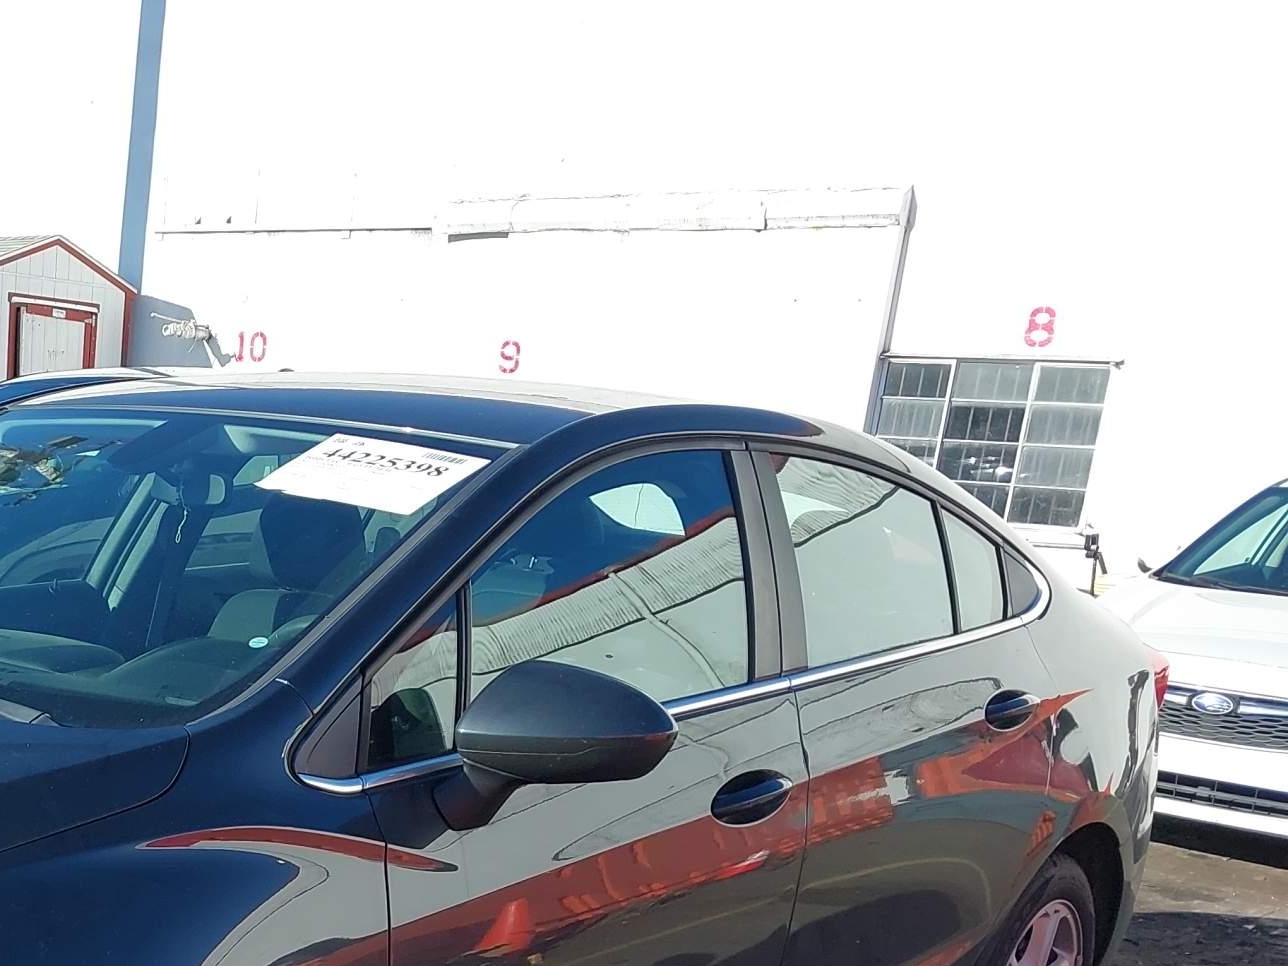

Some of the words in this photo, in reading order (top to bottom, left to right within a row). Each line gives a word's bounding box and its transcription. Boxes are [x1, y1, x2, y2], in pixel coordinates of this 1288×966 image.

[1024, 306, 1056, 347] 8
[234, 331, 268, 362] 10
[499, 340, 521, 374] 9
[323, 448, 449, 477] 44225398
